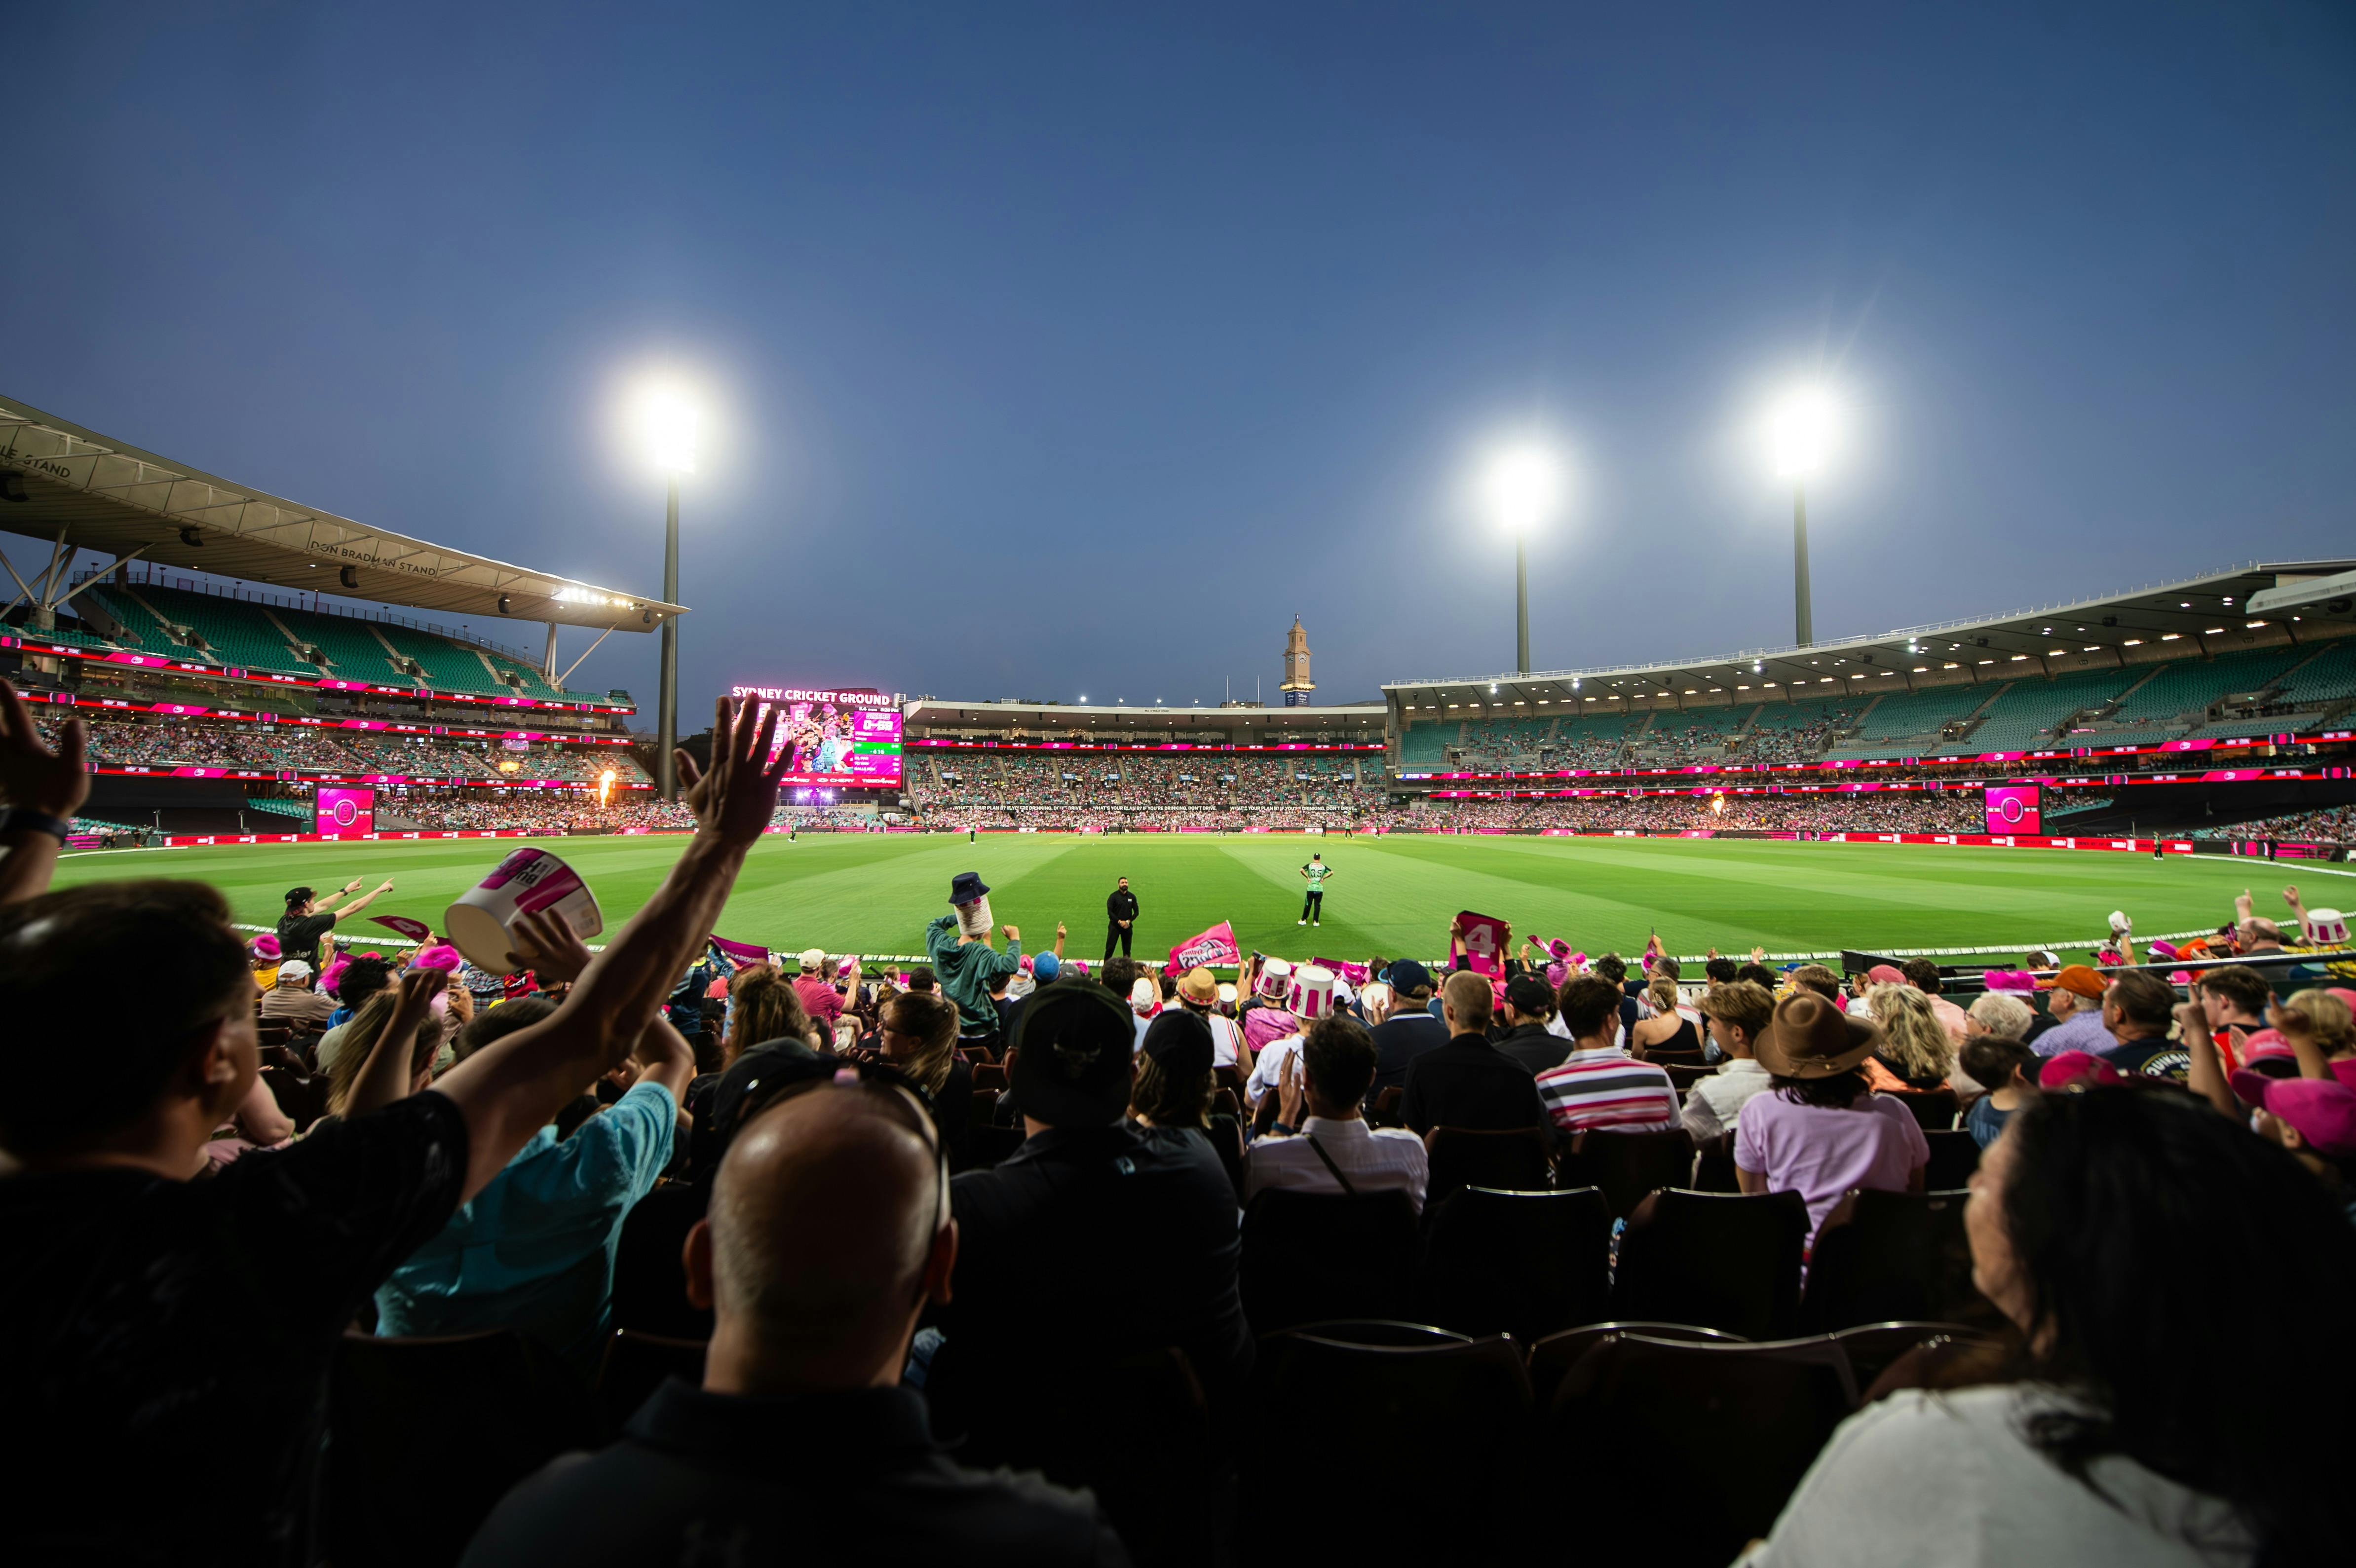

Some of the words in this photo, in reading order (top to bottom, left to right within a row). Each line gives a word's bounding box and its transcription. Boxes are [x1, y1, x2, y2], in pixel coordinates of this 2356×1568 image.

[399, 561, 436, 576] STAND
[784, 689, 837, 703] CRICKET
[838, 693, 890, 706] GROUND
[795, 709, 805, 722] 6
[866, 712, 891, 720] SIXERS
[771, 729, 784, 744] 6
[1311, 869, 1322, 878] 35
[1465, 923, 1496, 958] 4
